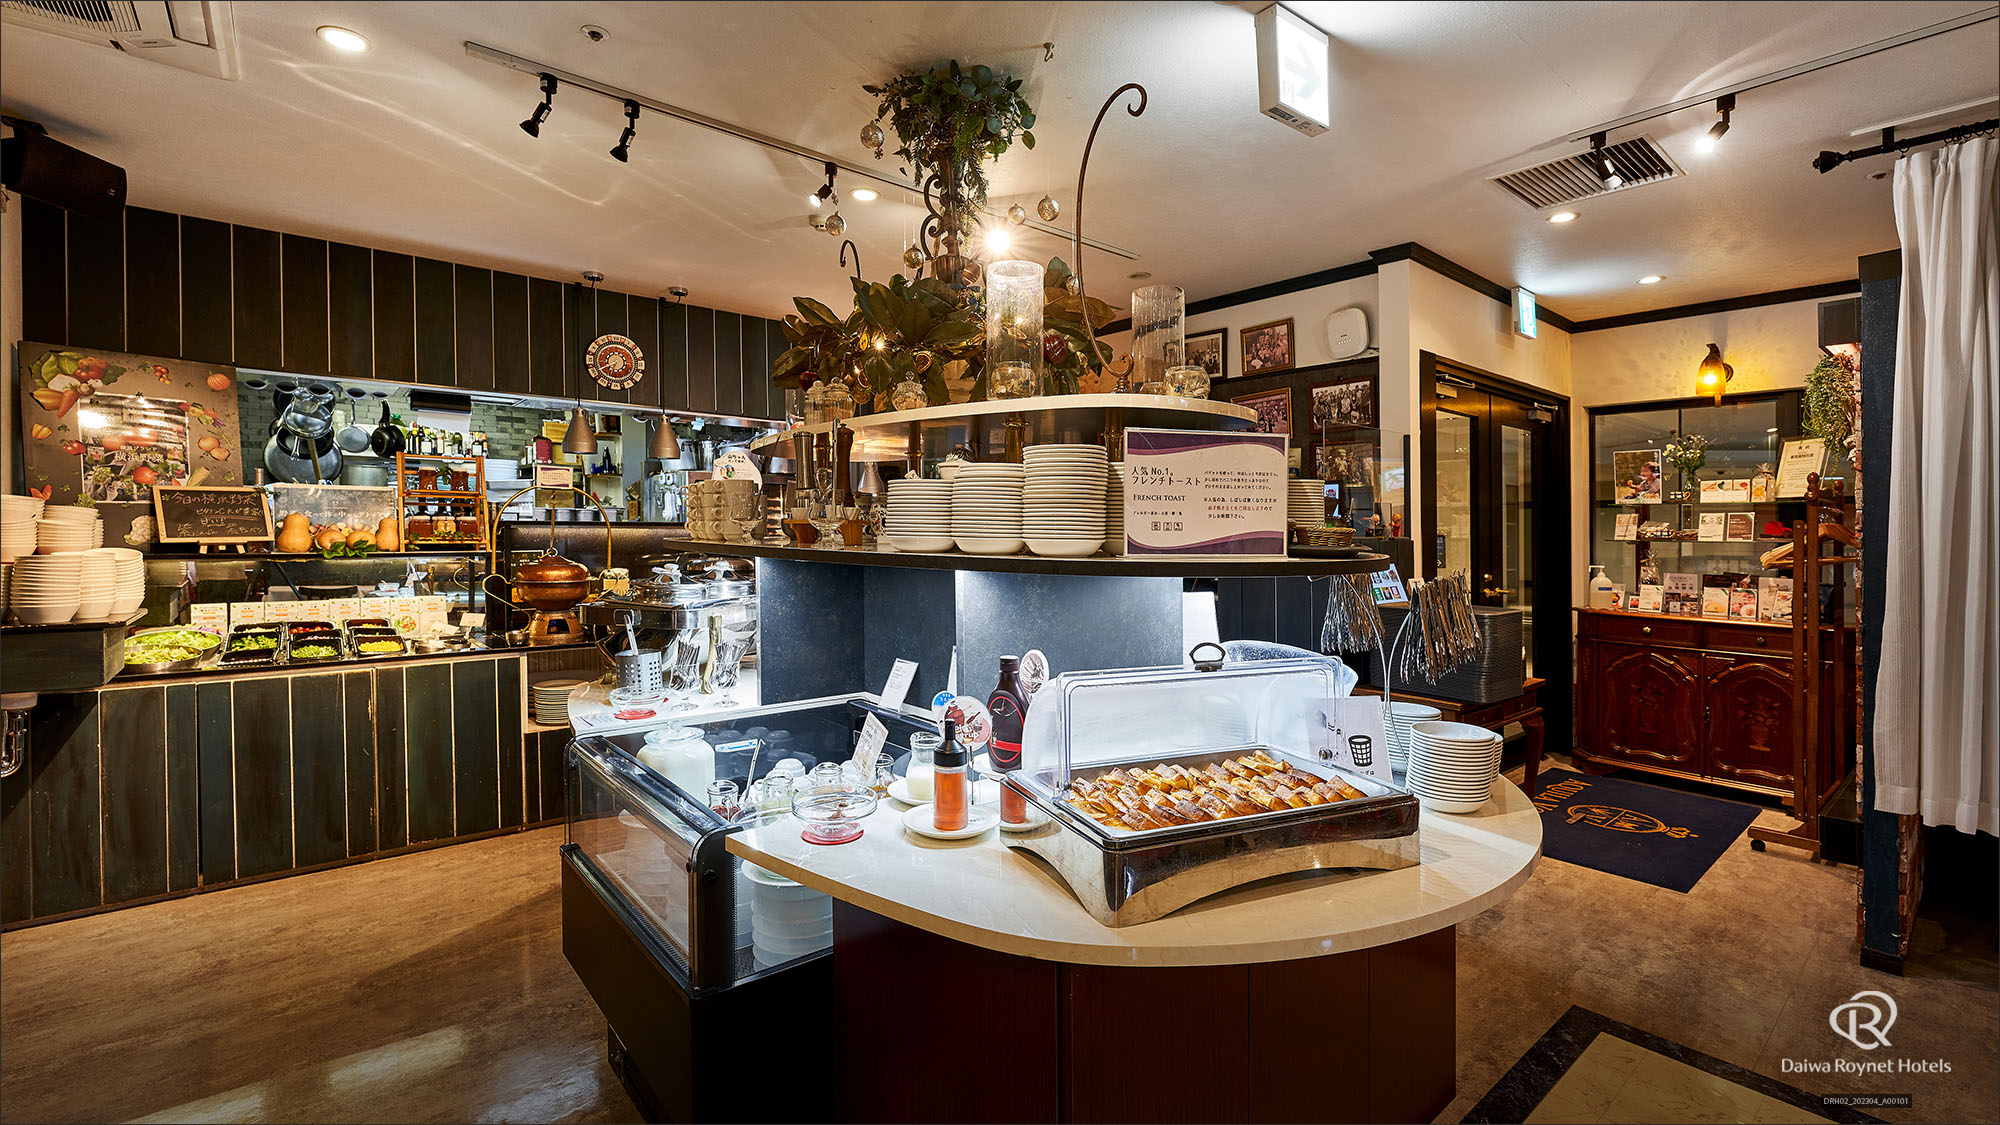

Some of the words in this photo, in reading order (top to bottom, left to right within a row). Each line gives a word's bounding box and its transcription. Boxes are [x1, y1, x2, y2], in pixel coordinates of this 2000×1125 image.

[1131, 465, 1149, 476] 人気
[1132, 476, 1202, 486] フレンチトースト
